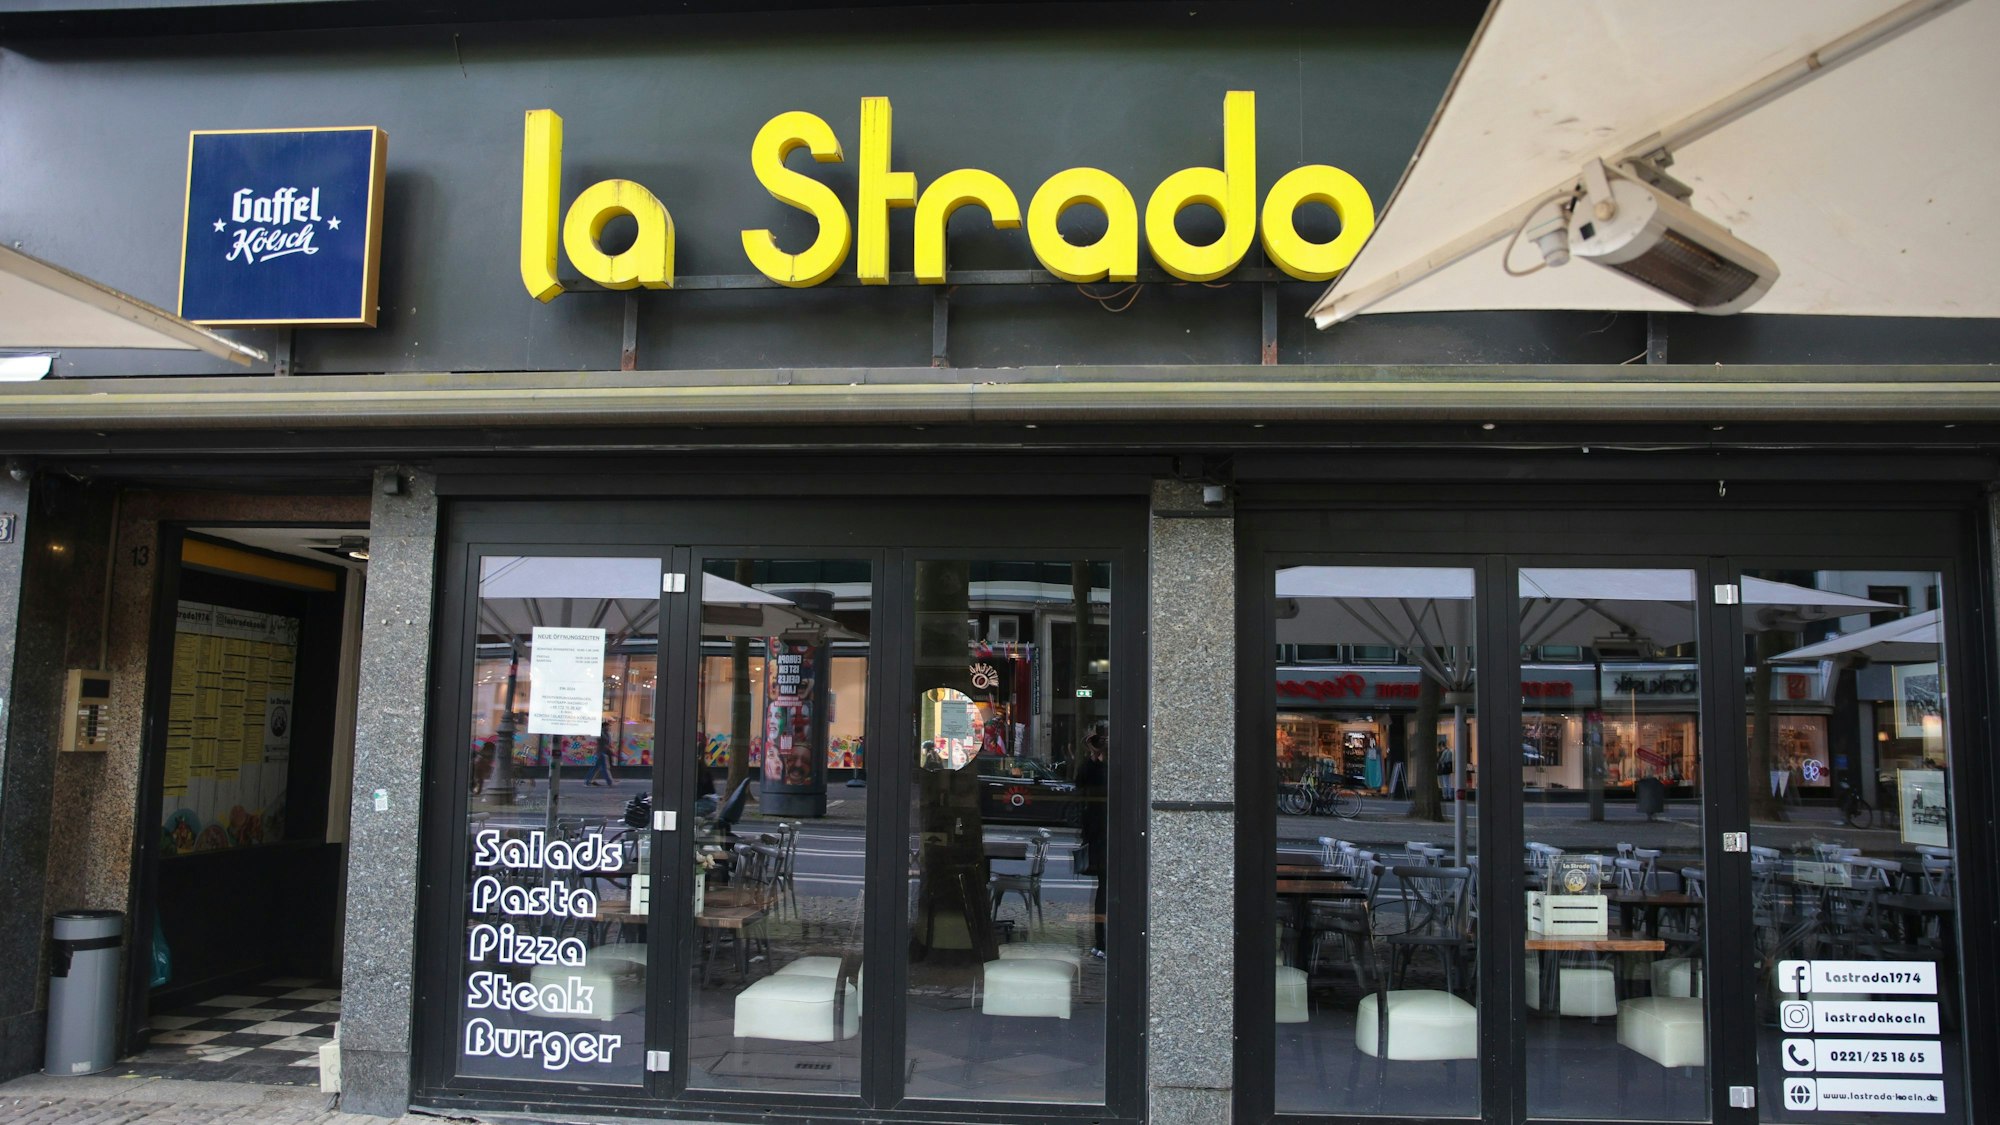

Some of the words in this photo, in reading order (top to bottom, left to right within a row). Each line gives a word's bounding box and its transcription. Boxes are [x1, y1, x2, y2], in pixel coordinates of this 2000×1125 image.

[231, 186, 322, 225] Gaffel
[226, 223, 319, 264] Kölsch
[130, 545, 149, 566] 13
[474, 829, 623, 872] Salads
[472, 875, 597, 918] Pasta
[469, 923, 587, 966] Pizza
[467, 971, 594, 1014] Steak
[1824, 1012, 1926, 1024] lastradakoeln
[465, 1017, 621, 1071] Burger
